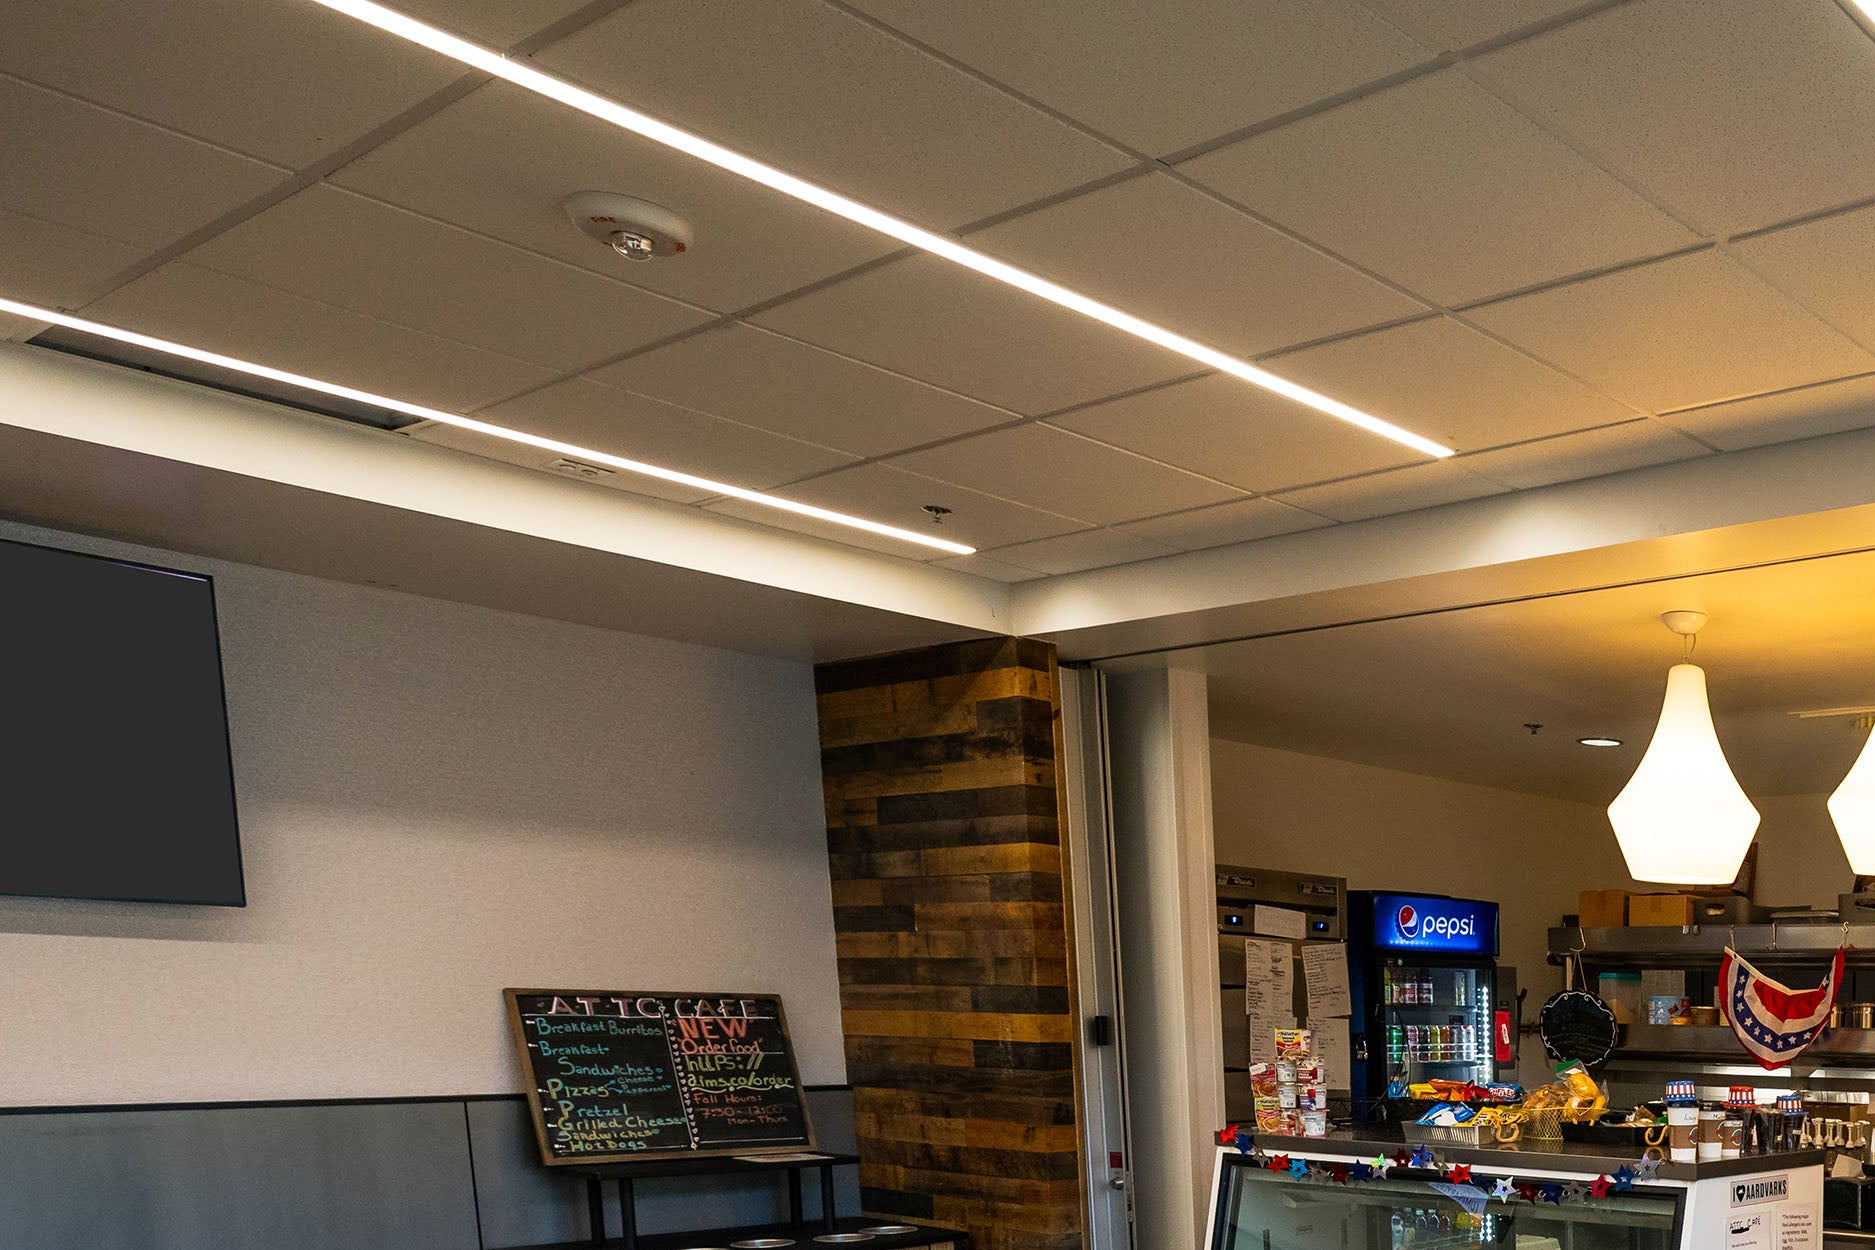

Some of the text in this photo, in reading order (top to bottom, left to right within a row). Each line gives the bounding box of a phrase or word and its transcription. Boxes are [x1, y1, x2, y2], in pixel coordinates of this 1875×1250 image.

[1422, 914, 1475, 940] pepsi
[535, 1017, 663, 1036] Breakfast Burritos
[693, 1092, 718, 1105] Fall
[558, 1100, 628, 1119] Pretzel
[557, 1116, 623, 1131] Grilled
[569, 1140, 648, 1152] Hot Dogs
[1745, 1179, 1787, 1201] AARDVARKS
